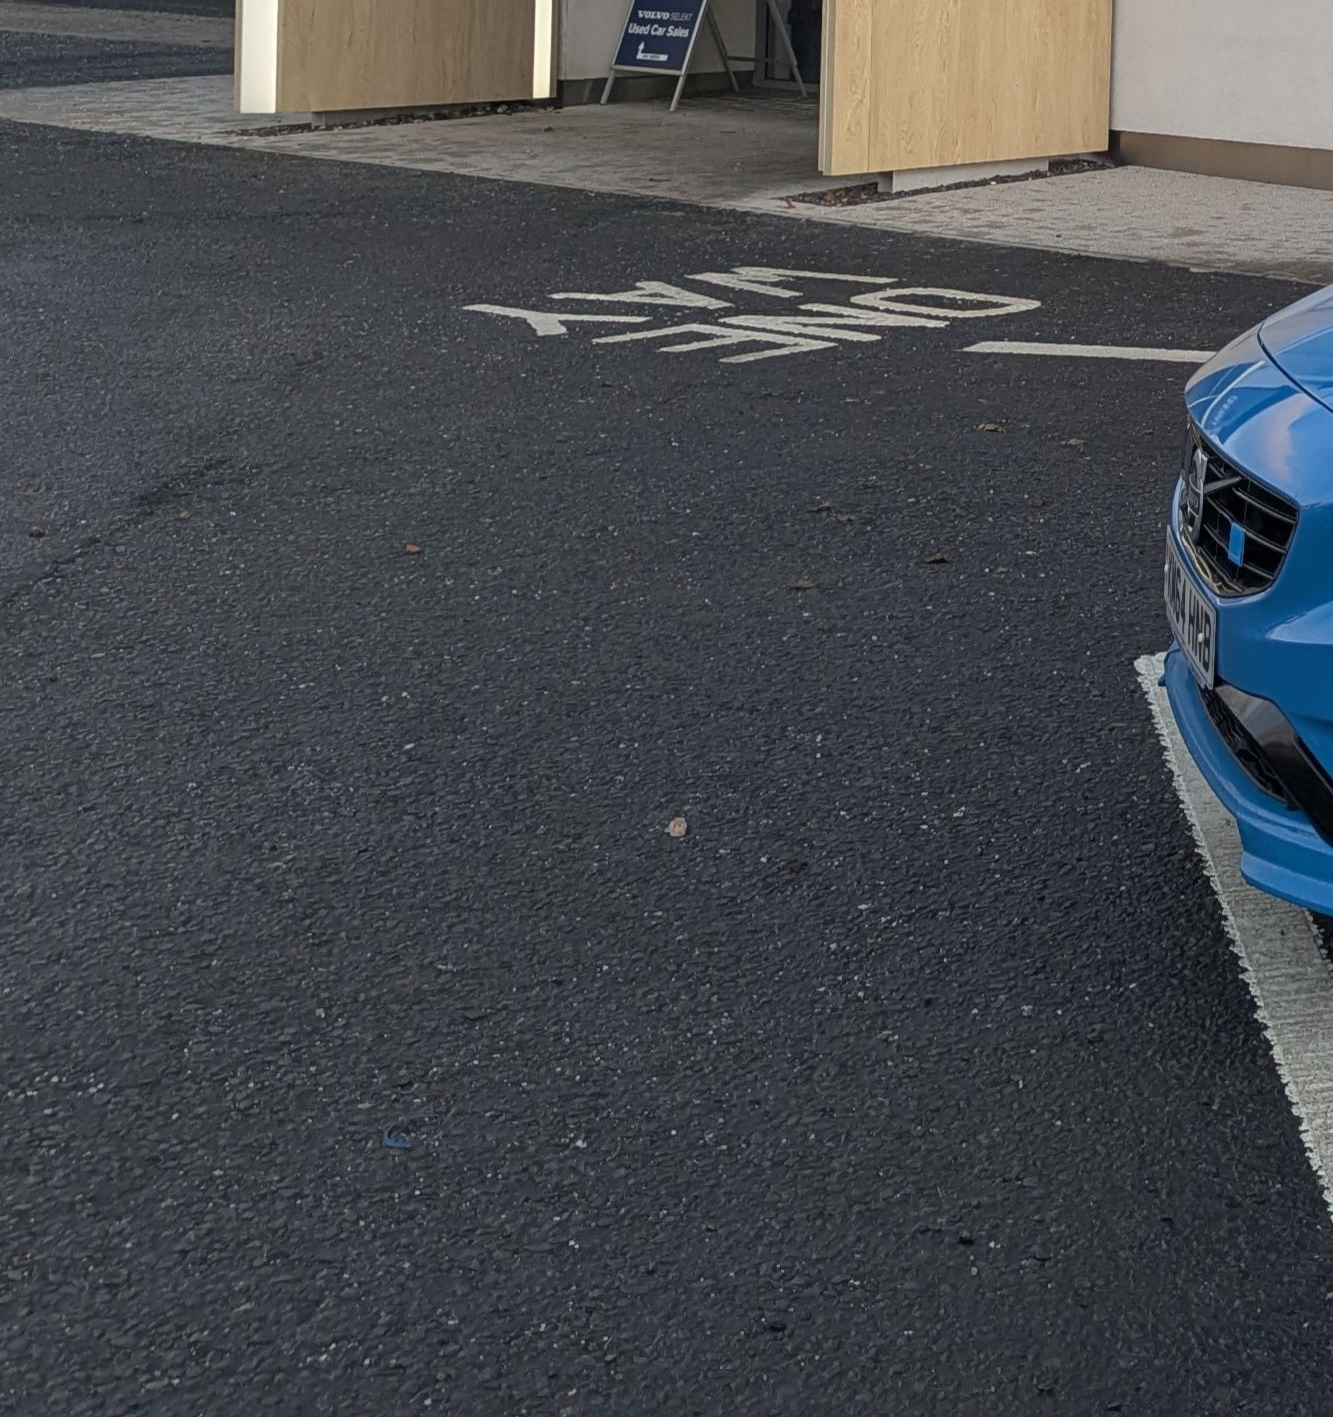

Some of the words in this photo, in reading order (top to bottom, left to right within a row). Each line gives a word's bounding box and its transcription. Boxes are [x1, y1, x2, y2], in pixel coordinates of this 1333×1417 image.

[628, 23, 650, 34] Used
[651, 24, 666, 36] Car
[666, 25, 690, 38] Sales
[638, 10, 670, 20] VOLVO
[462, 266, 898, 336] WAY
[592, 287, 1042, 364] ONE
